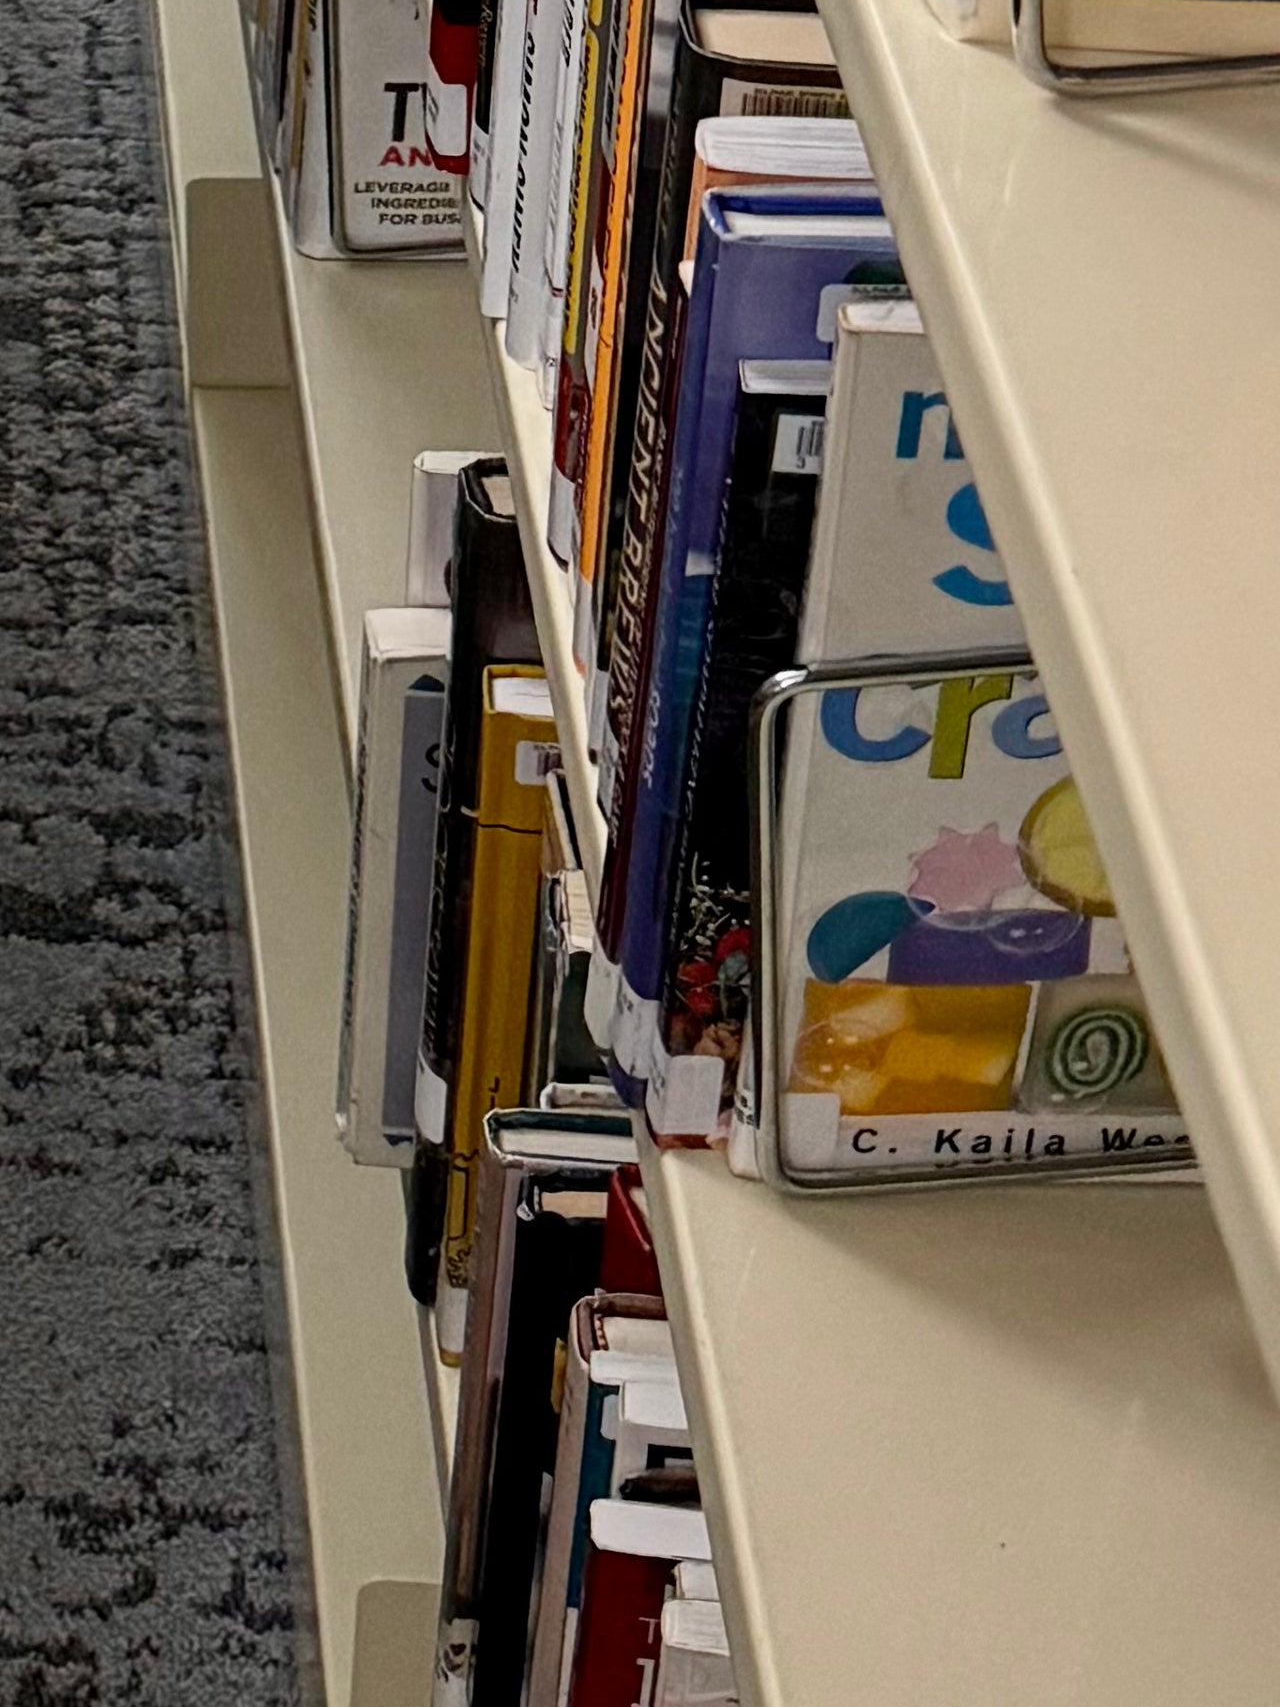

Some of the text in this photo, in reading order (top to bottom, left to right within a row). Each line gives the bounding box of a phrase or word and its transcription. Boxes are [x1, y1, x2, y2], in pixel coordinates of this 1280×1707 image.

[378, 213, 418, 226] FOR
[624, 273, 668, 527] ANCIENT
[851, 1128, 898, 1155] C.
[933, 1127, 1066, 1156] Kaila
